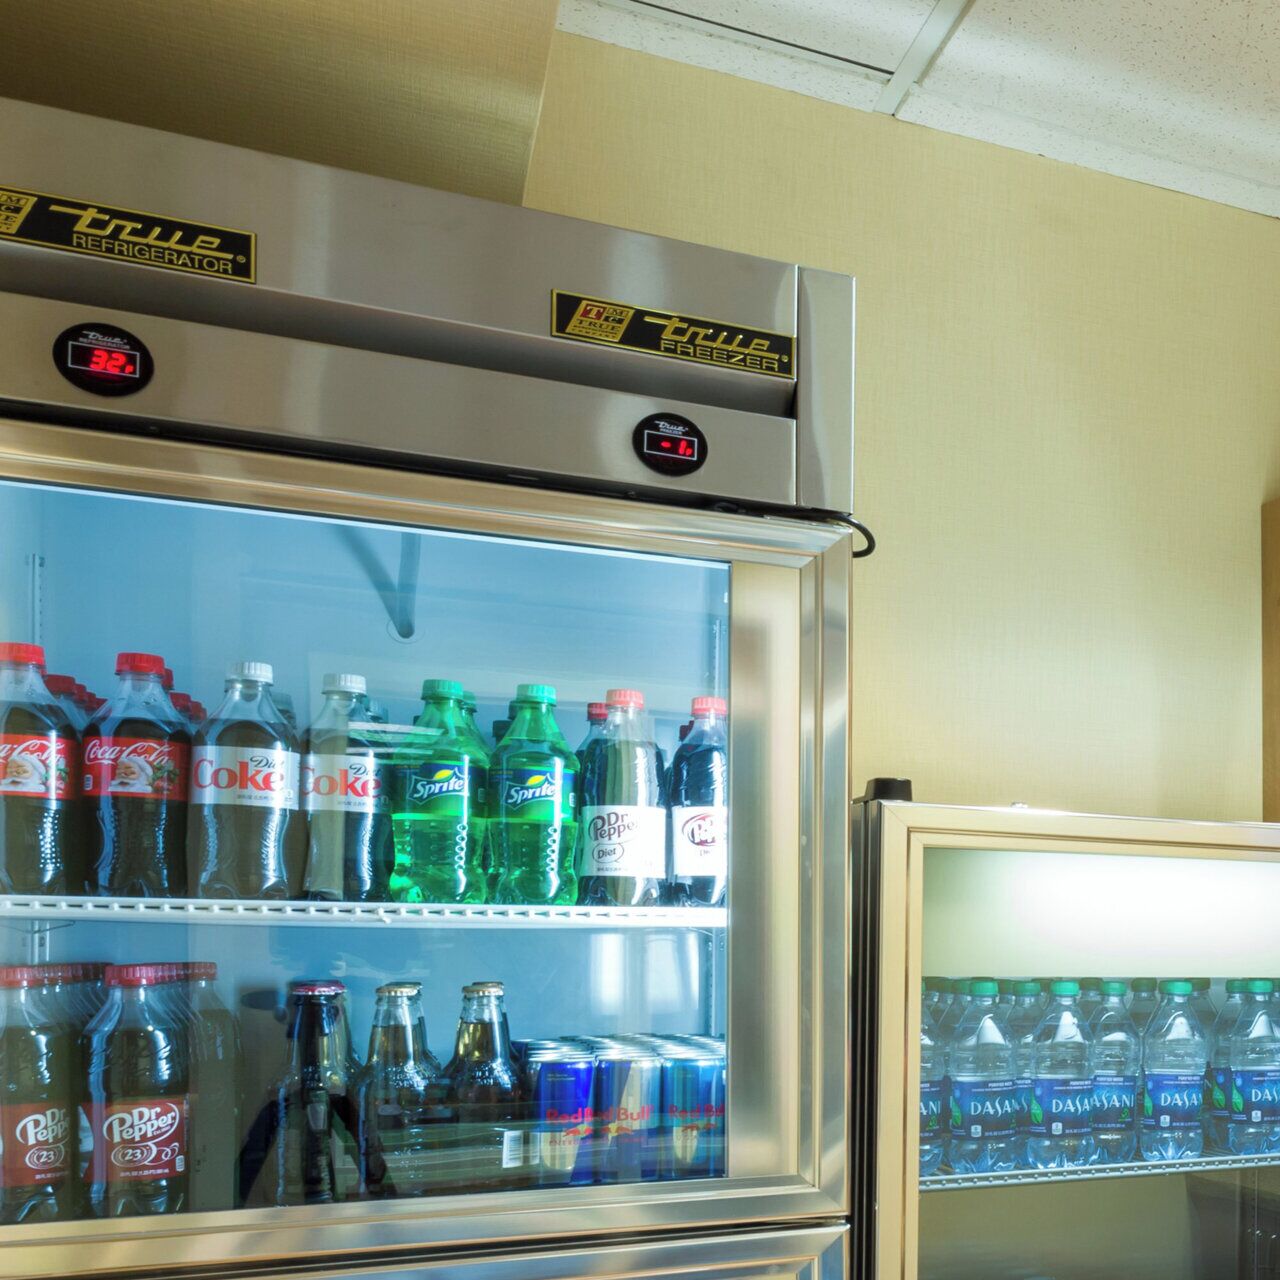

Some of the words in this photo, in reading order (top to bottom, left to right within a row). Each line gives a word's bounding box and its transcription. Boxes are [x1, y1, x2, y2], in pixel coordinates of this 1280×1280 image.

[73, 233, 232, 274] REFRIGERATOR
[660, 340, 779, 371] FREEZER
[84, 738, 174, 766] Coca-Cola
[192, 757, 286, 792] Coke
[412, 777, 466, 799] Sprite
[507, 780, 558, 804] Sprite
[606, 811, 629, 826] Dr
[597, 846, 618, 860] Diet
[50, 1108, 66, 1125] Dr
[129, 1107, 161, 1125] Dr
[616, 1104, 649, 1121] Bull
[103, 1109, 176, 1144] Pepper
[37, 1149, 55, 1162] 23
[124, 1148, 143, 1162] 23
